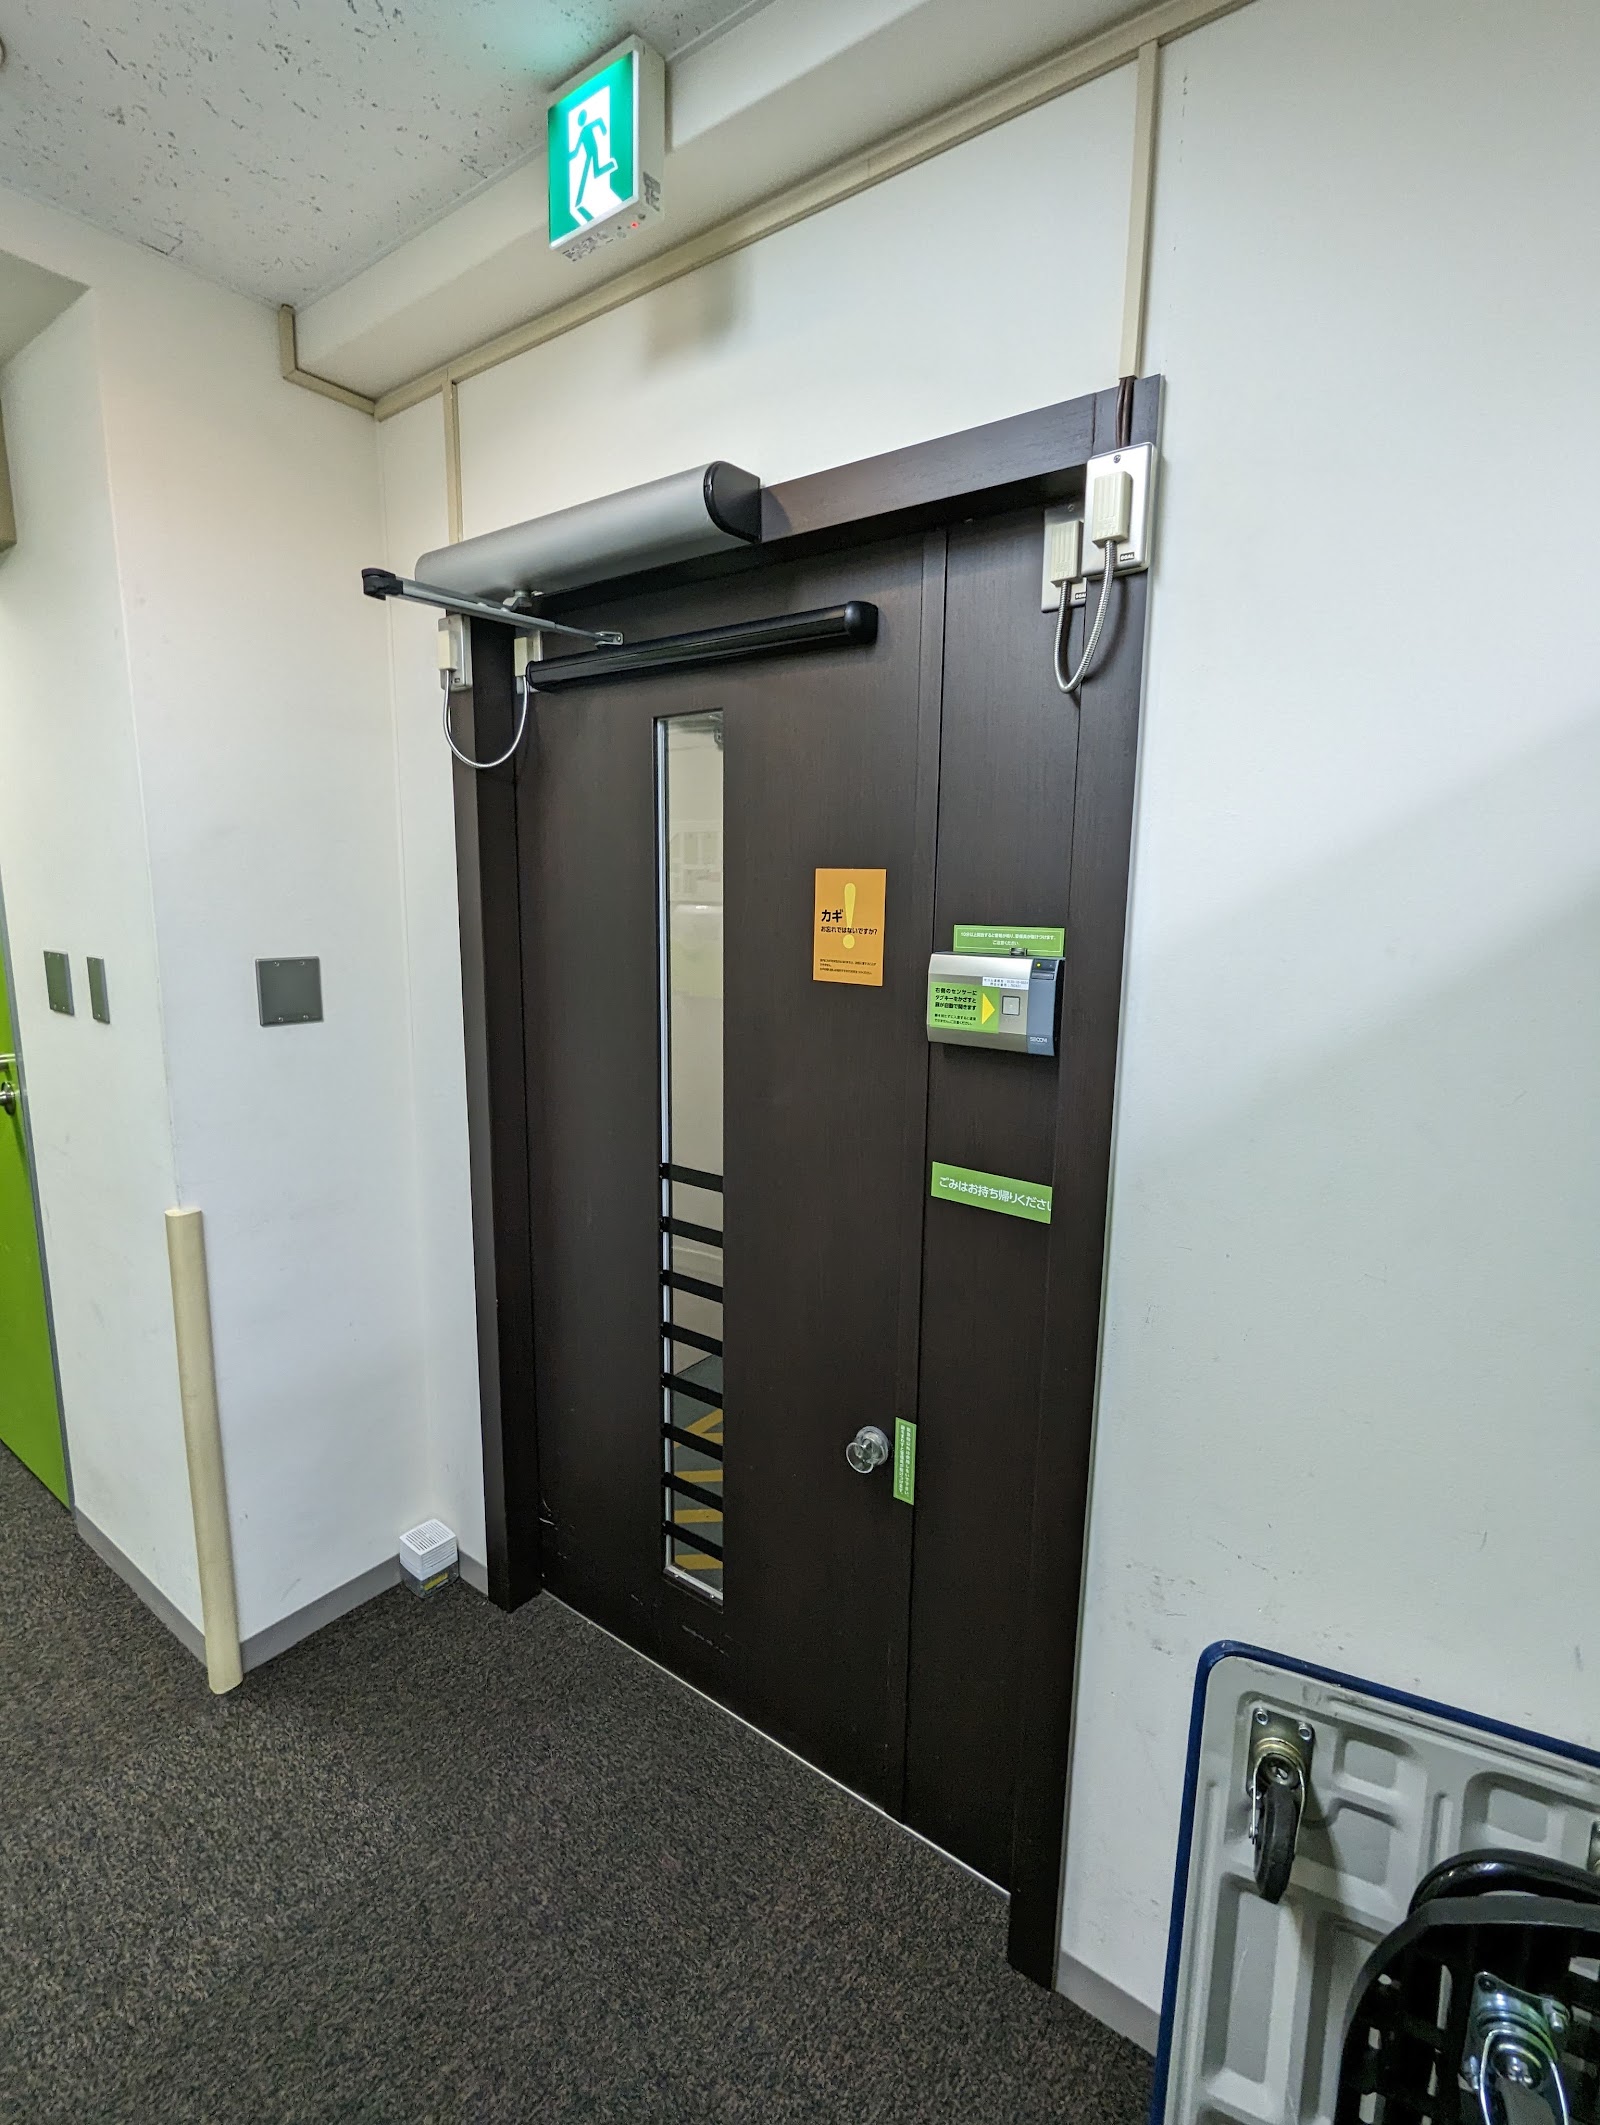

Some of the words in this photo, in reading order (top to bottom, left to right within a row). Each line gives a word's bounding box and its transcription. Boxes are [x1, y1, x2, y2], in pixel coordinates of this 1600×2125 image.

[821, 909, 844, 923] カギ
[935, 987, 978, 996] 右側のセンサーに
[935, 995, 977, 1004] タグキーをかざすと
